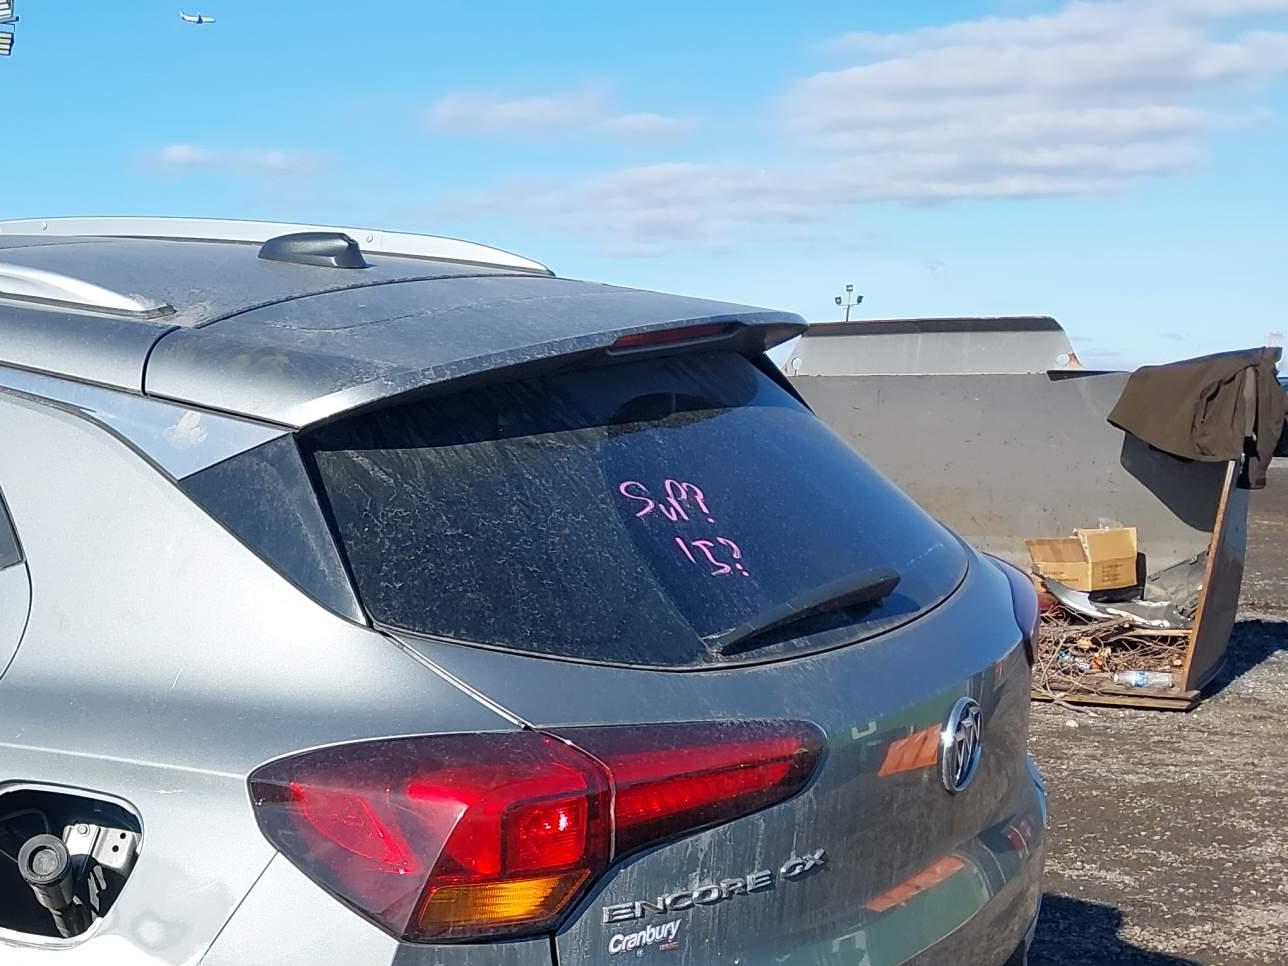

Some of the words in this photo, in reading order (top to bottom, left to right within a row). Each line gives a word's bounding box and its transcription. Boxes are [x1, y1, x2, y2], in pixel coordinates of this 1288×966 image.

[601, 868, 773, 924] ENCORE
[779, 848, 825, 880] GX
[608, 918, 682, 955] Cranbury
